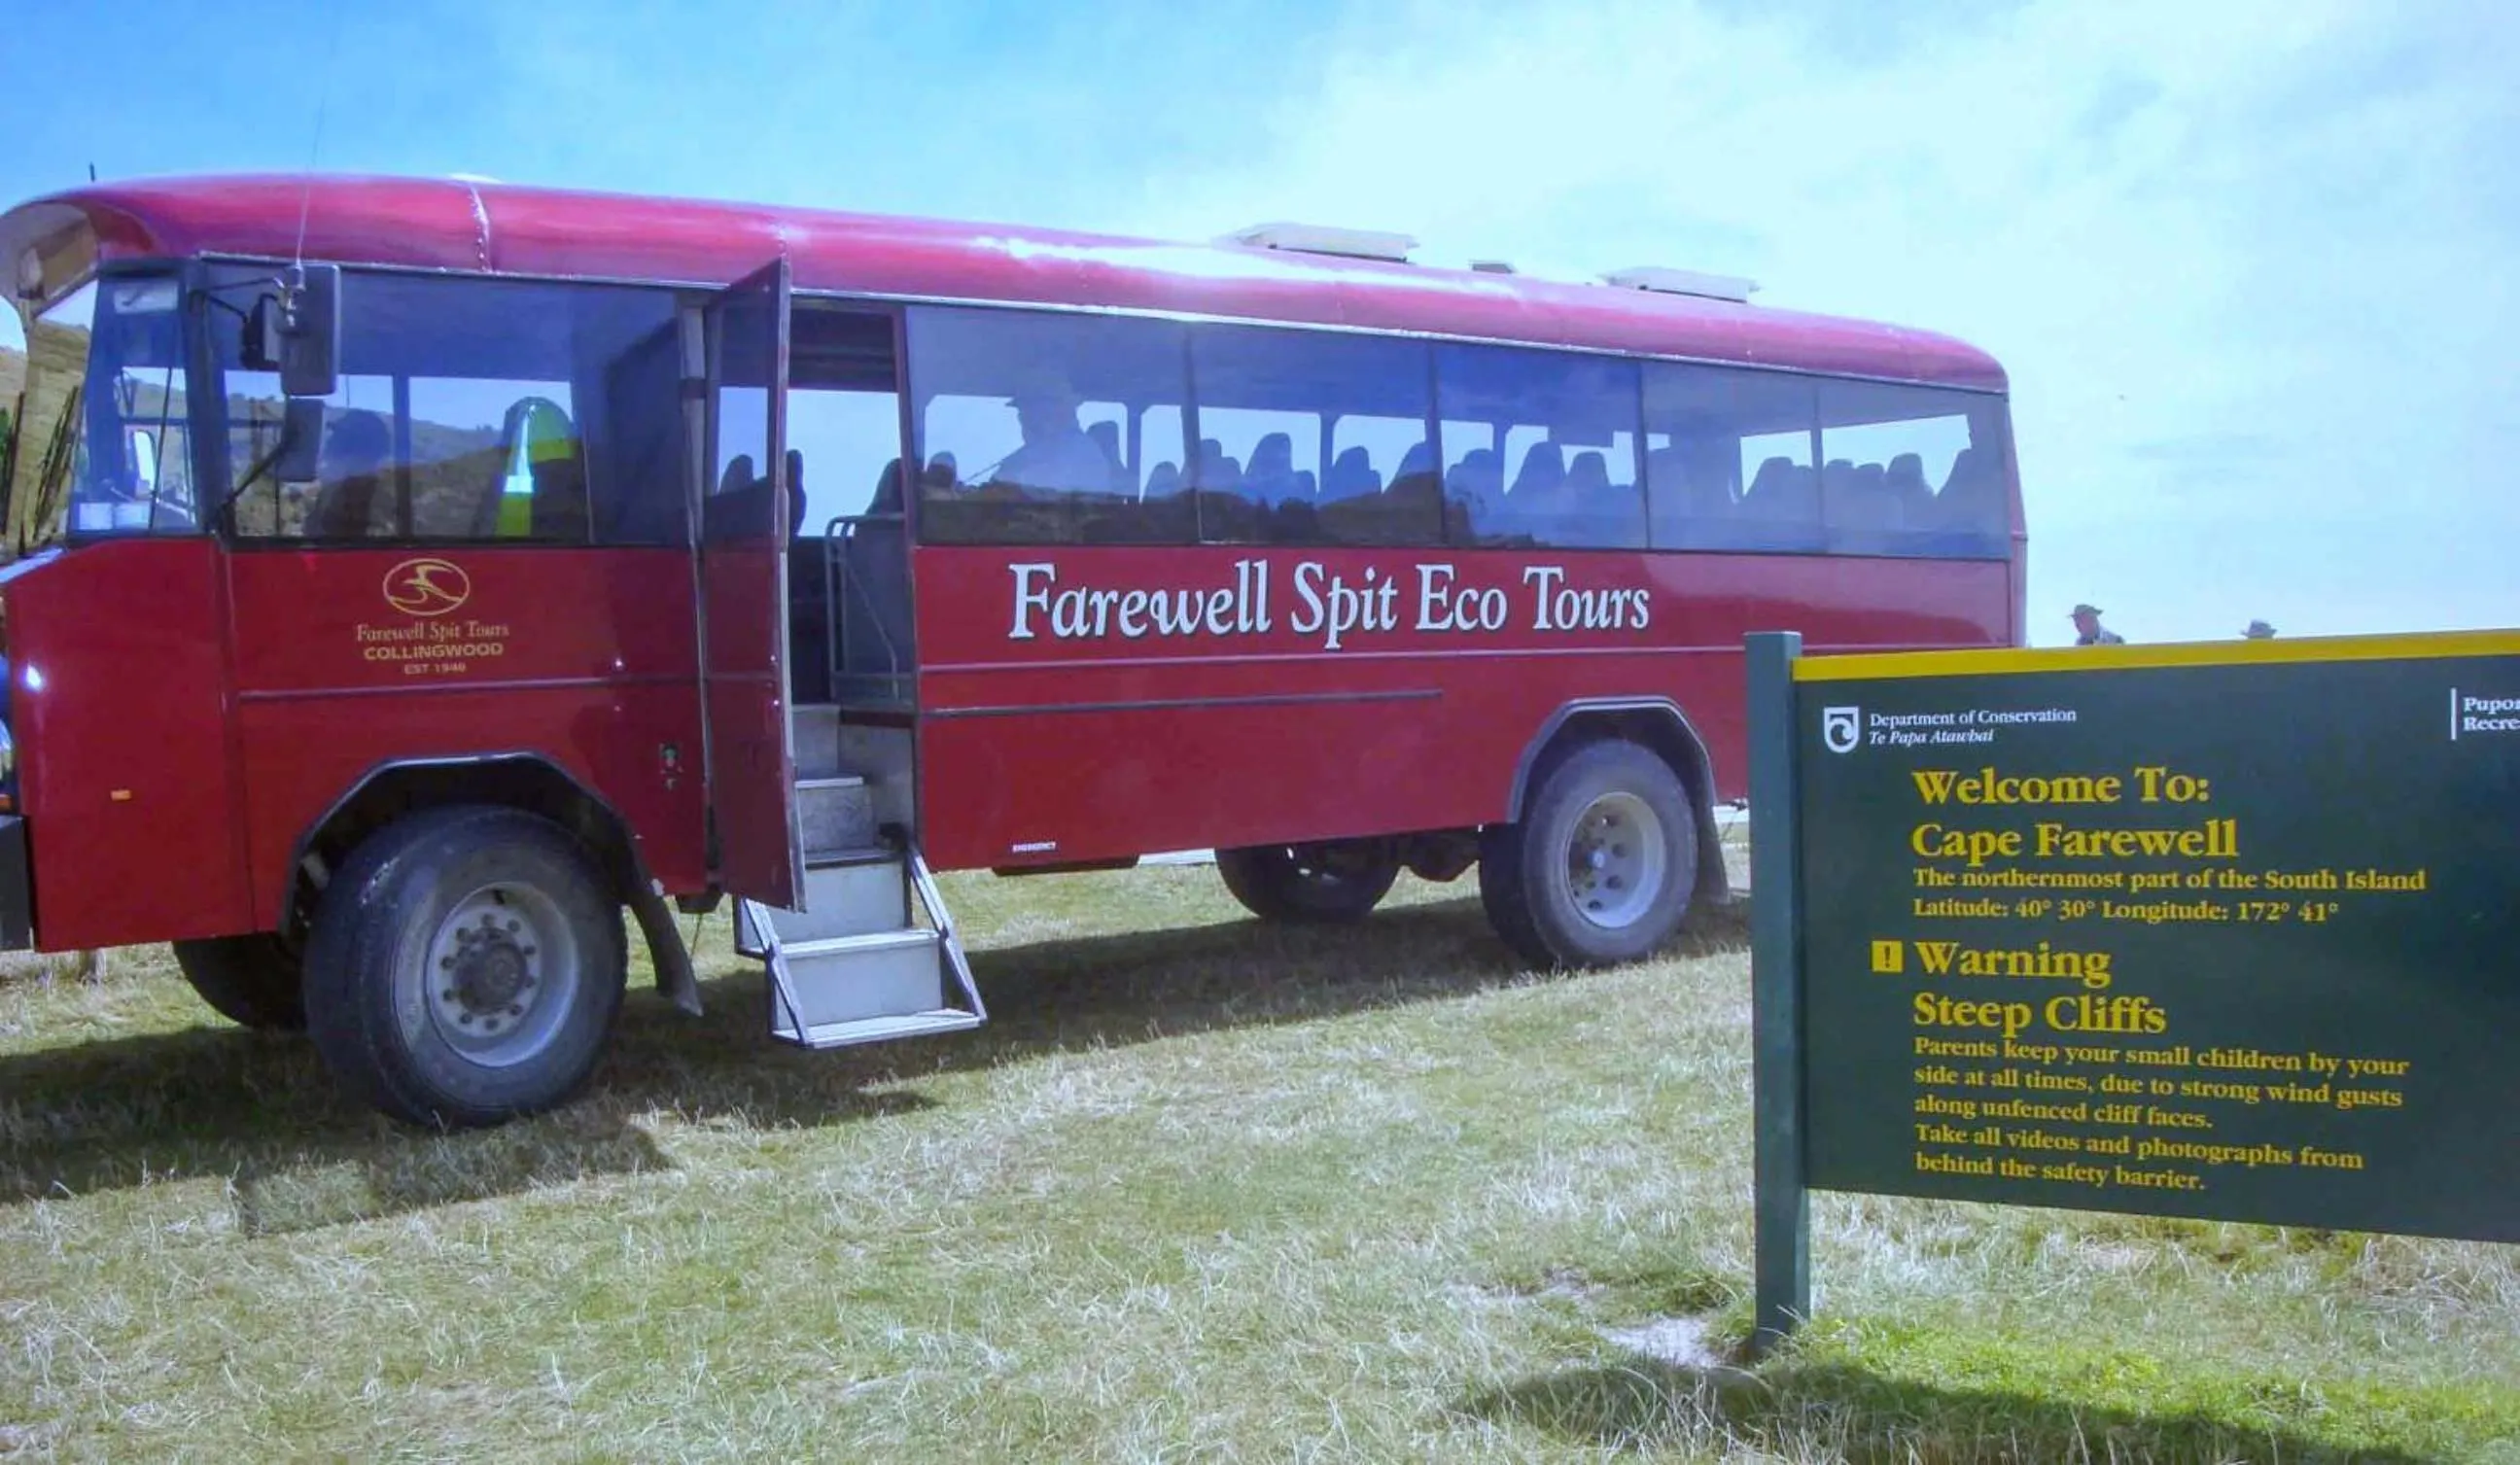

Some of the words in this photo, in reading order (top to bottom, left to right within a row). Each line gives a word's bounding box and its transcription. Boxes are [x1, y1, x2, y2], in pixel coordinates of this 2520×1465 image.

[1008, 558, 1272, 639] Farewell
[1290, 561, 1398, 649] Spit
[1416, 563, 1507, 631] Eco
[1522, 566, 1650, 630] Tours
[357, 623, 424, 643] Farewell
[430, 622, 460, 642] Spit
[466, 619, 509, 638] Tours
[364, 643, 504, 660] COLLINGWOOD
[403, 663, 429, 675] EST
[1870, 712, 1955, 729] Department
[1959, 711, 1974, 725] of
[1978, 708, 2078, 724] Conservation
[1869, 731, 1885, 745] Te
[1890, 731, 1927, 747] Papa
[1912, 768, 2121, 805] Welcome
[2135, 767, 2210, 803] To:
[1912, 823, 2021, 868] Cape
[2037, 819, 2238, 858] Farewell
[1914, 868, 1956, 888] The
[1962, 868, 2123, 889] northernmost
[2130, 870, 2181, 891] part
[2187, 869, 2214, 889] of
[2218, 869, 2258, 889] the
[2264, 869, 2339, 890] South
[2346, 869, 2427, 891] Island
[1914, 899, 2010, 918] Latitude:
[2015, 900, 2054, 918] 40°
[2059, 900, 2097, 919] 30°
[2102, 900, 2229, 923] Longitude:
[2237, 900, 2291, 920] 172°
[1915, 941, 2112, 989] Warning
[1913, 992, 2032, 1037] Steep
[2045, 994, 2167, 1034] Cliffs
[1914, 1036, 1998, 1058] Parents
[2004, 1038, 2058, 1063] keep
[2064, 1047, 2120, 1065] your
[2125, 1048, 2190, 1066] small
[2197, 1049, 2301, 1071] children
[2308, 1052, 2340, 1076] by
[2347, 1059, 2410, 1077] your
[1914, 1066, 1958, 1086] side
[1964, 1069, 1984, 1087] at
[1991, 1069, 2019, 1088] all
[2025, 1071, 2095, 1094] times,
[2100, 1074, 2143, 1095] due
[2150, 1080, 2174, 1096] to
[2181, 1081, 2260, 1104] strong
[2267, 1082, 2330, 1104] wind
[2336, 1089, 2402, 1108] gusts
[1914, 1096, 1977, 1120] along
[1982, 1099, 2087, 1122] unfenced
[2093, 1104, 2141, 1125] cliff
[2147, 1107, 2212, 1129] faces.
[1915, 1123, 1968, 1144] Take
[1974, 1127, 2001, 1146] all
[2007, 1130, 2080, 1152] videos
[2085, 1134, 2130, 1155] and
[2137, 1137, 2293, 1166] photographs
[2300, 1147, 2363, 1169] from
[1915, 1152, 1994, 1174] behind
[2000, 1157, 2037, 1177] the
[2042, 1161, 2110, 1186] safety
[2116, 1167, 2205, 1190] barrier.
